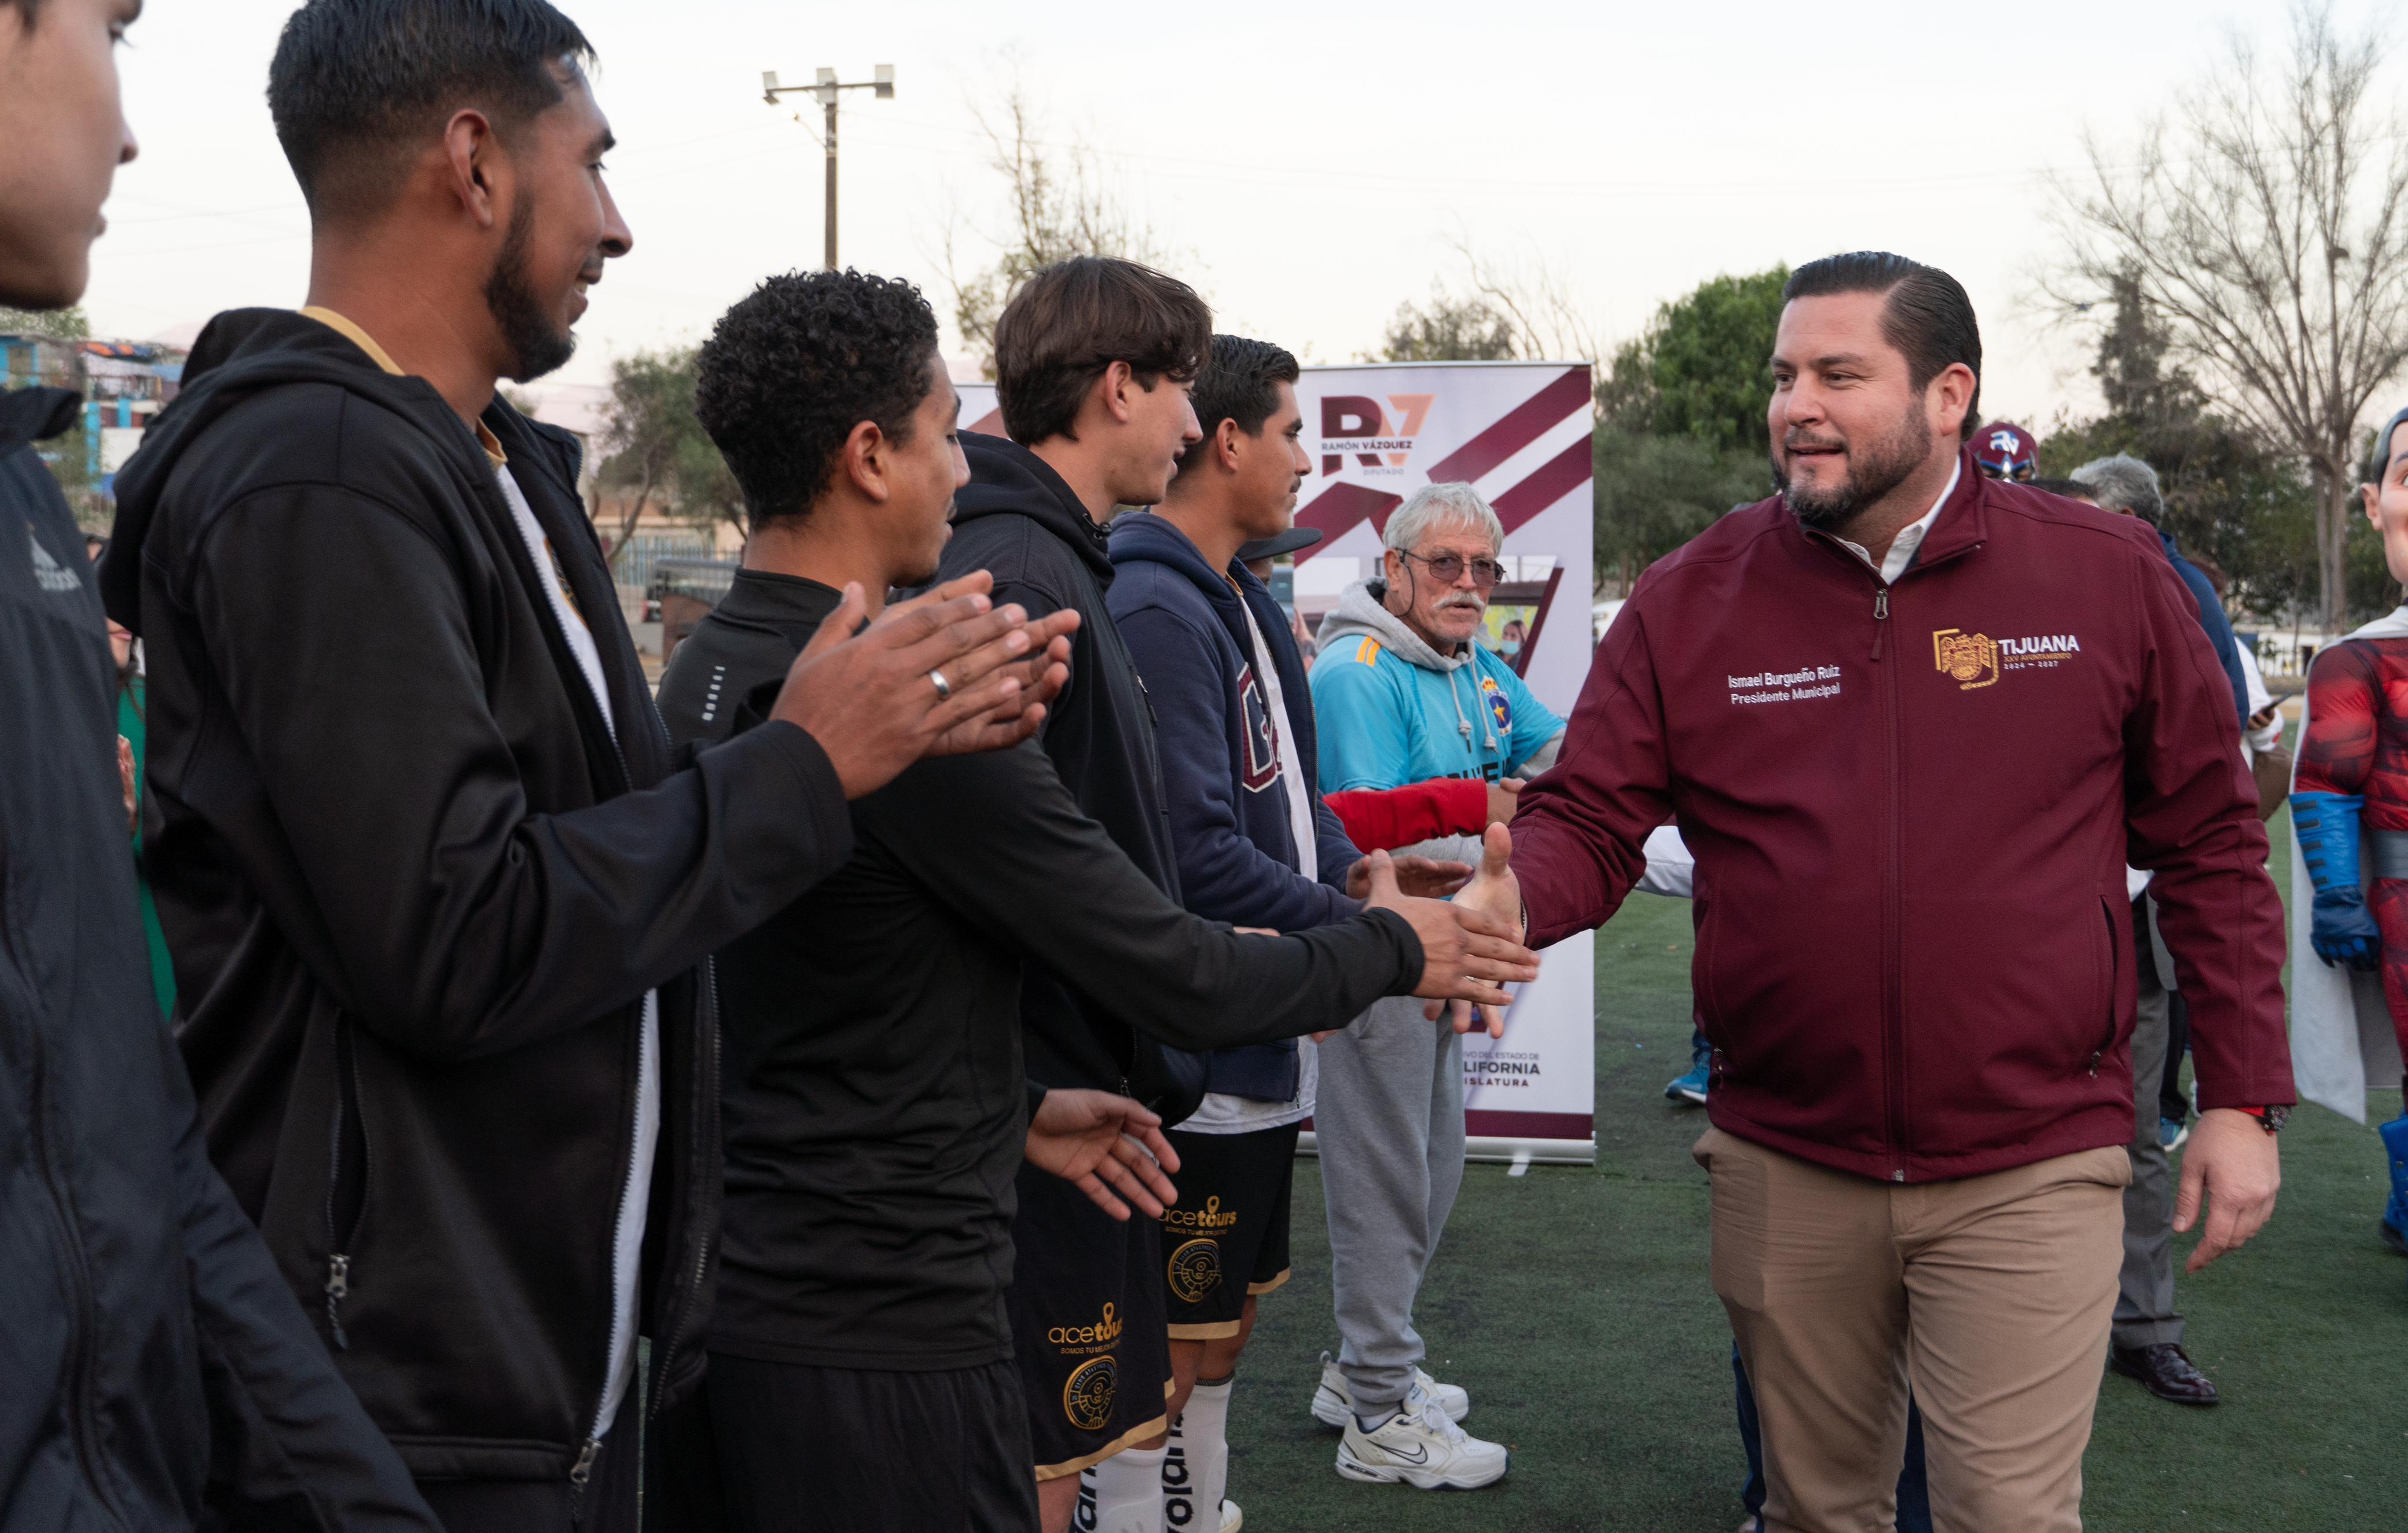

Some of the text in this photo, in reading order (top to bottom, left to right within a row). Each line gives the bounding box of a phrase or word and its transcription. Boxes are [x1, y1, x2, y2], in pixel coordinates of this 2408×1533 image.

[1322, 440, 1412, 450] RAMÓN VÁZQUEZ
[1998, 635, 2080, 655] TIJUANA
[2020, 652, 2072, 661] AYUNTAMIENTO
[1728, 664, 1841, 688] Ismael Burgueño Ruiz
[1731, 681, 1841, 705] Presidente Municipal
[1464, 1061, 1540, 1074] LIFORNIA
